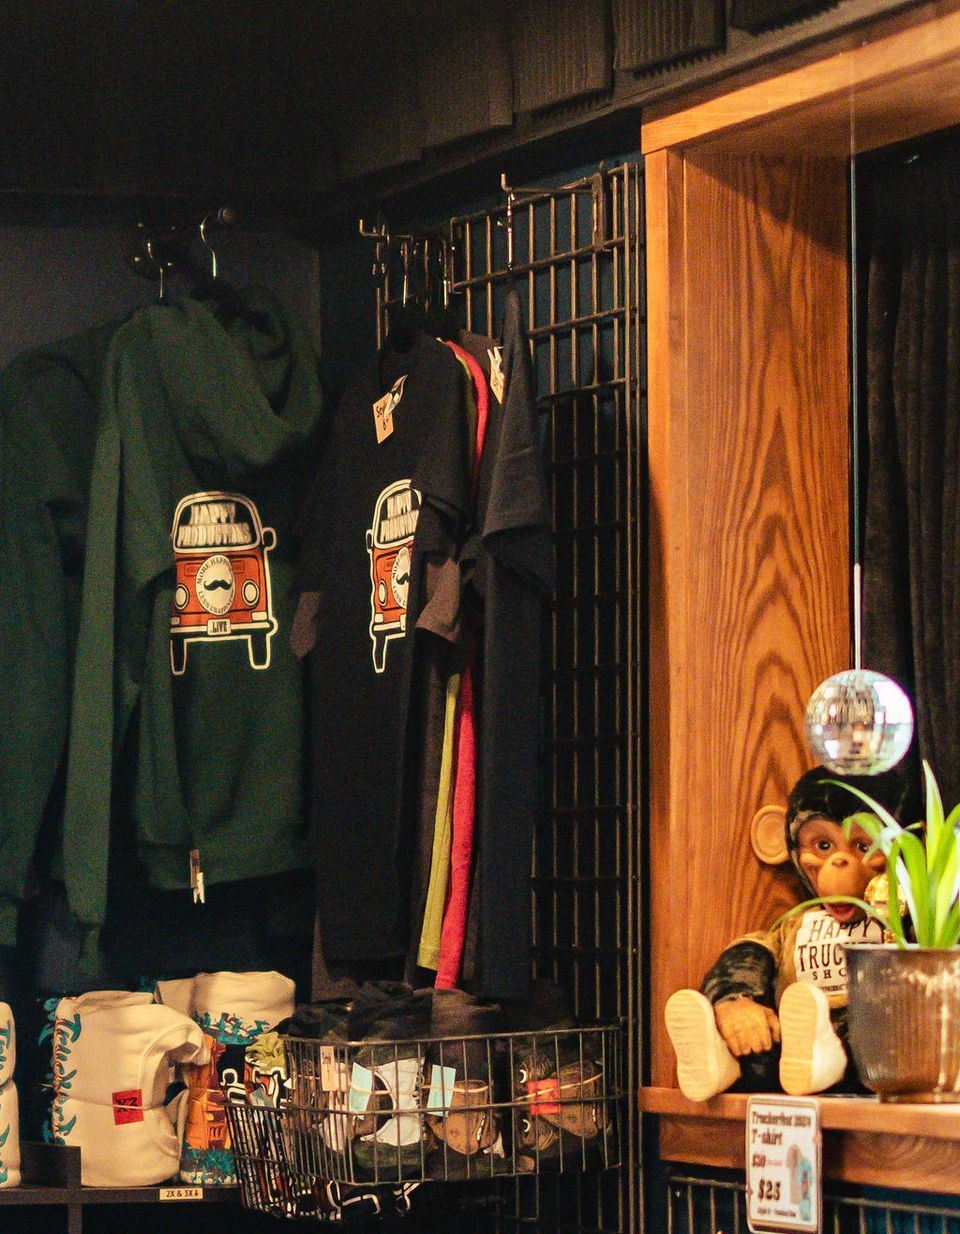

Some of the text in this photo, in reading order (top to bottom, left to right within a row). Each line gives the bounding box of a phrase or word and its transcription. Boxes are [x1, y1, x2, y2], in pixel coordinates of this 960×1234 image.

[751, 1128, 783, 1146] T-shirt
[166, 1190, 176, 1198] 2X
[184, 1190, 194, 1198] 3X
